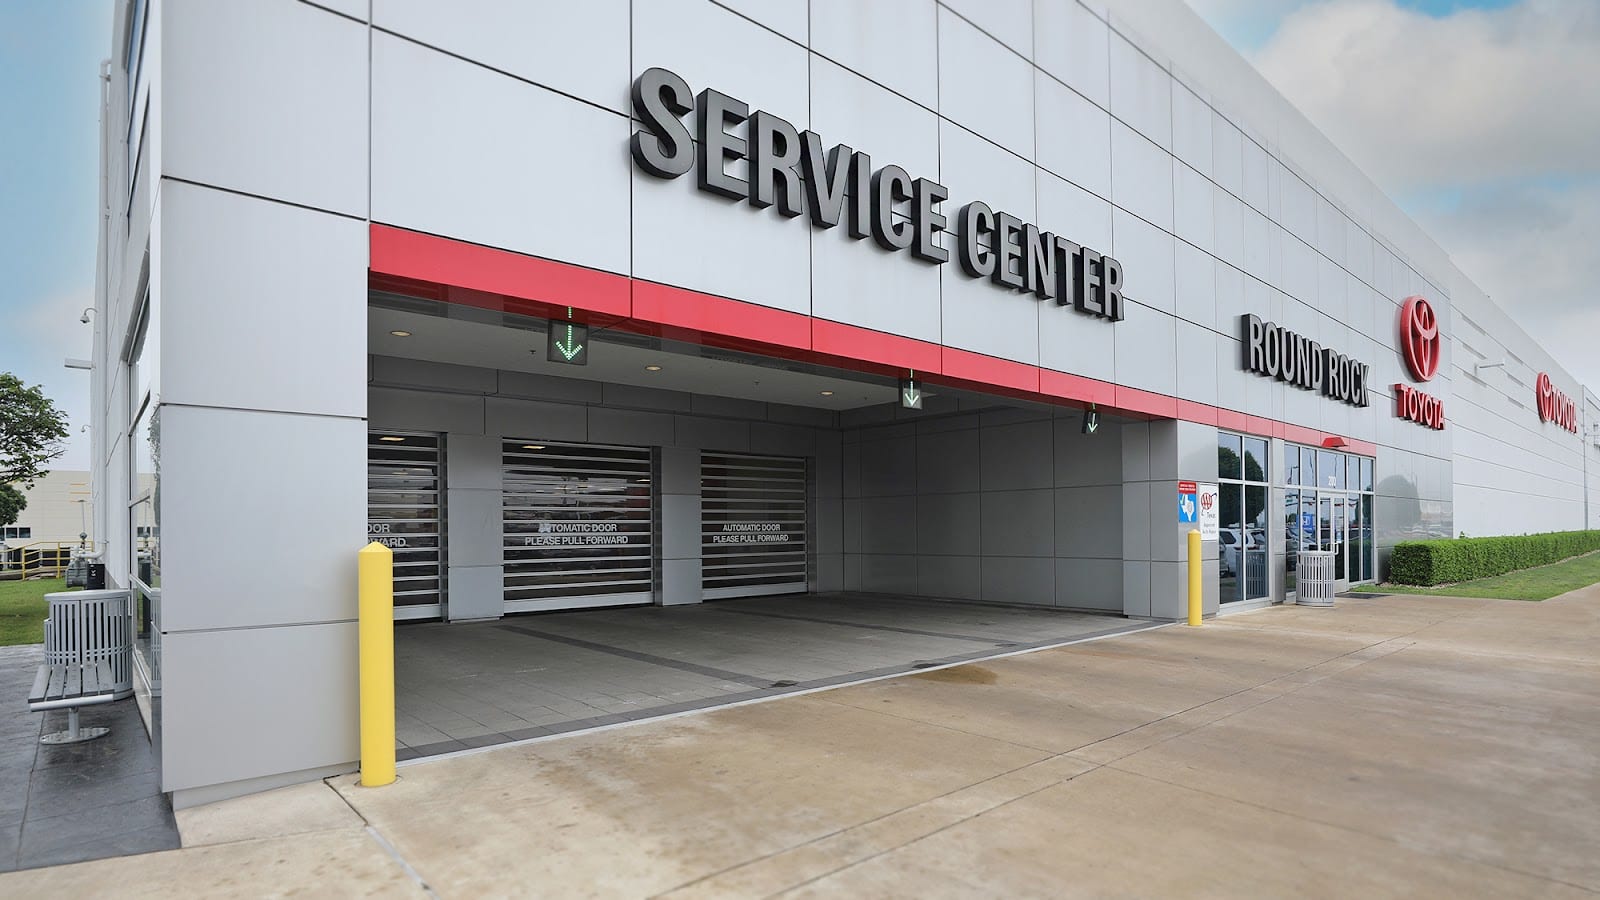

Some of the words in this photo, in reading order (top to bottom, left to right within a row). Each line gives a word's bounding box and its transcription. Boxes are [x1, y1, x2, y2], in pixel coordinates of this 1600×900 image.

[631, 67, 949, 264] SERVICE
[958, 201, 1125, 322] CENTER
[1241, 313, 1323, 390] ROUND
[1323, 348, 1370, 408] ROCK
[1394, 383, 1446, 431] TOYOTA
[1550, 384, 1578, 434] TOYOTA
[525, 536, 561, 546] PLEASE
[562, 536, 585, 545] PULL
[586, 536, 629, 545] FORWARD
[592, 523, 617, 532] DOOR
[713, 535, 739, 543] PLEASE
[740, 535, 756, 543] PULL
[757, 534, 789, 542] FORWARD
[722, 524, 761, 532] AUTOMATIC
